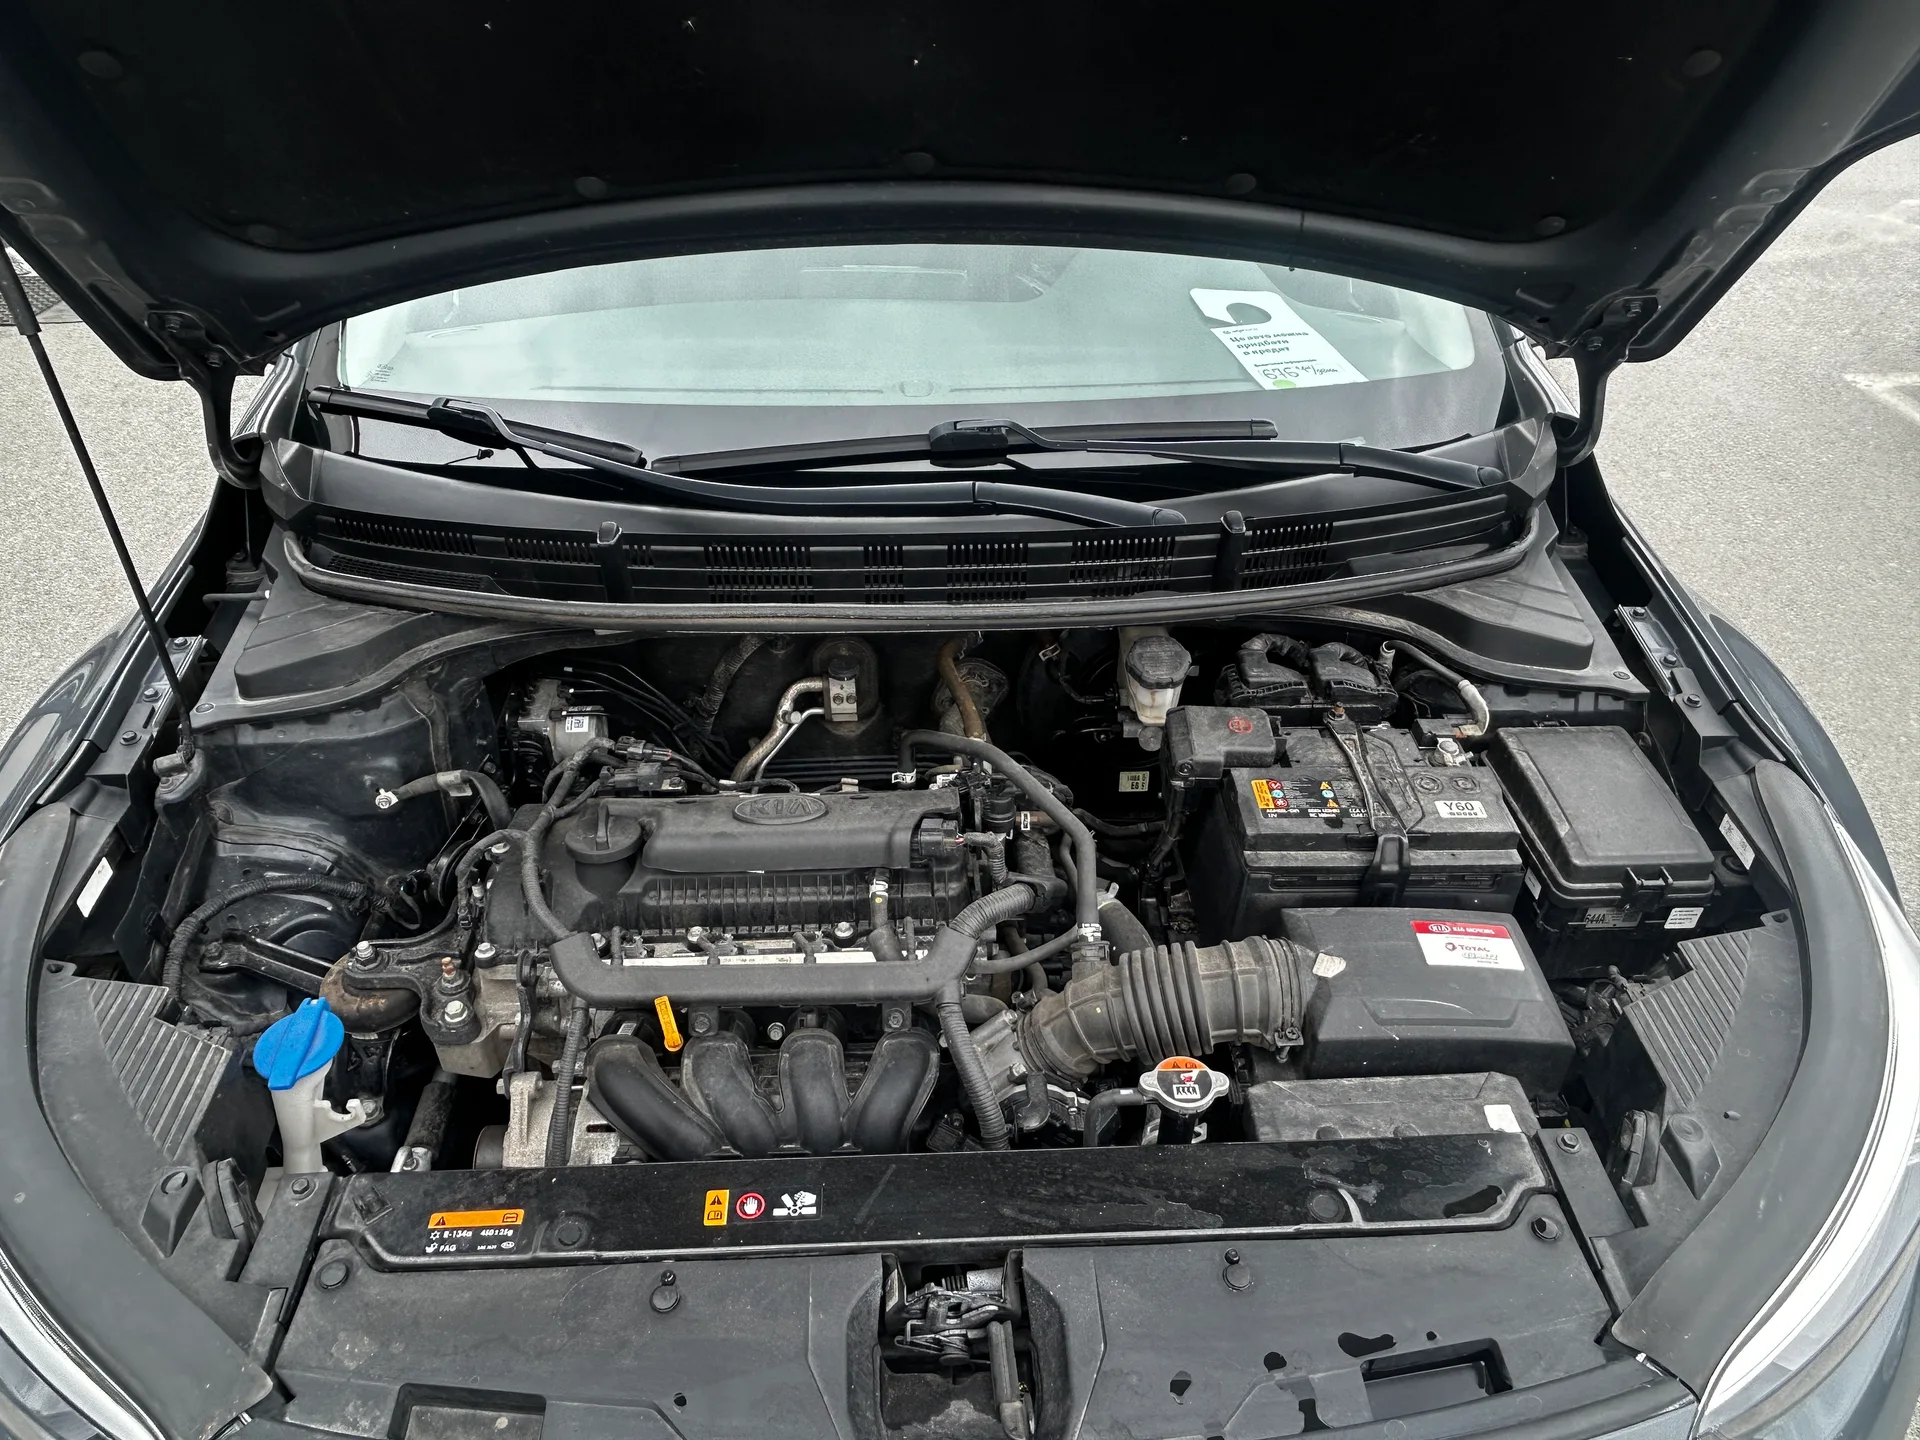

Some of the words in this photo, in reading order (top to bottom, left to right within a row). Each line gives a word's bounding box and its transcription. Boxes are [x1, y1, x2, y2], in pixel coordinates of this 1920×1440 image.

[749, 798, 812, 815] KIA
[1443, 801, 1475, 811] Y60
[1458, 944, 1490, 952] TOTAL
